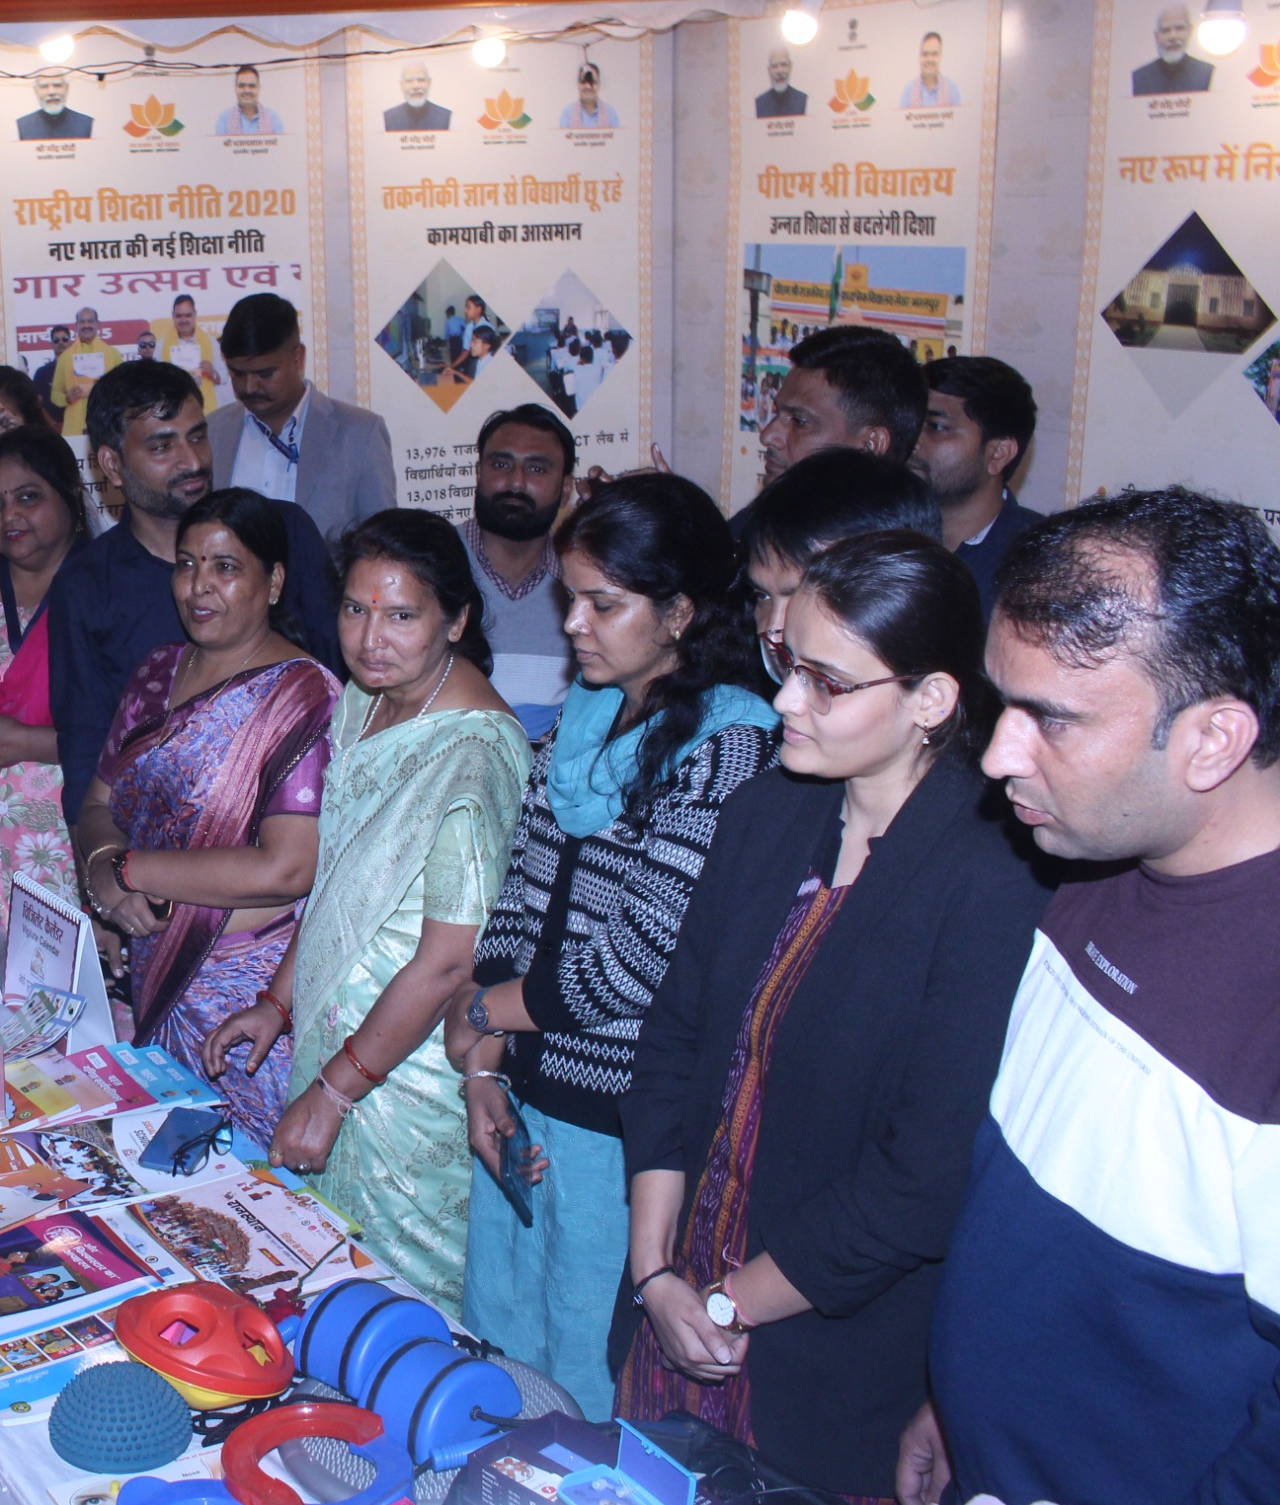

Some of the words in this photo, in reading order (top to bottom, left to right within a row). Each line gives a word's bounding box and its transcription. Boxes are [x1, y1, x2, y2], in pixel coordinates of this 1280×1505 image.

[1119, 155, 1158, 184] नए
[1162, 152, 1210, 183] रूप
[1214, 142, 1240, 182] में
[381, 176, 460, 210] तकनीकी
[462, 182, 500, 207] ज्ञान
[503, 174, 519, 206] से
[521, 173, 582, 205] विद्यार्थी
[583, 179, 602, 213] छू
[601, 172, 624, 203] रहे
[757, 164, 817, 199] पीएम
[820, 162, 851, 198] श्री
[855, 161, 957, 198] विद्यालय
[14, 189, 93, 231] राष्ट्रीय
[97, 187, 164, 223] शिक्षा
[167, 184, 223, 220] नीति
[228, 189, 296, 218] 2020
[426, 220, 496, 246] कामयाबी
[497, 225, 519, 243] का
[521, 222, 583, 243] आसमान
[769, 216, 802, 235] उन्नत
[804, 210, 838, 236] शिक्षा
[839, 209, 851, 236] से
[852, 209, 901, 236] बदलेगी
[903, 209, 937, 237] दिशा
[48, 242, 76, 262] नए
[80, 240, 122, 260] भारत
[124, 233, 149, 258] की
[151, 231, 177, 259] नई
[179, 231, 225, 256] शिक्षा
[227, 229, 266, 254] नीति
[97, 268, 211, 295] उत्सव
[620, 428, 629, 443] से
[406, 447, 446, 460] 13,976
[405, 462, 457, 481] विद्यार्थियों
[458, 461, 473, 476] को
[407, 488, 447, 503] 13,018
[455, 507, 472, 520] नए
[1095, 953, 1138, 995] EXPLORATION
[227, 1200, 266, 1233] राजस्थान
